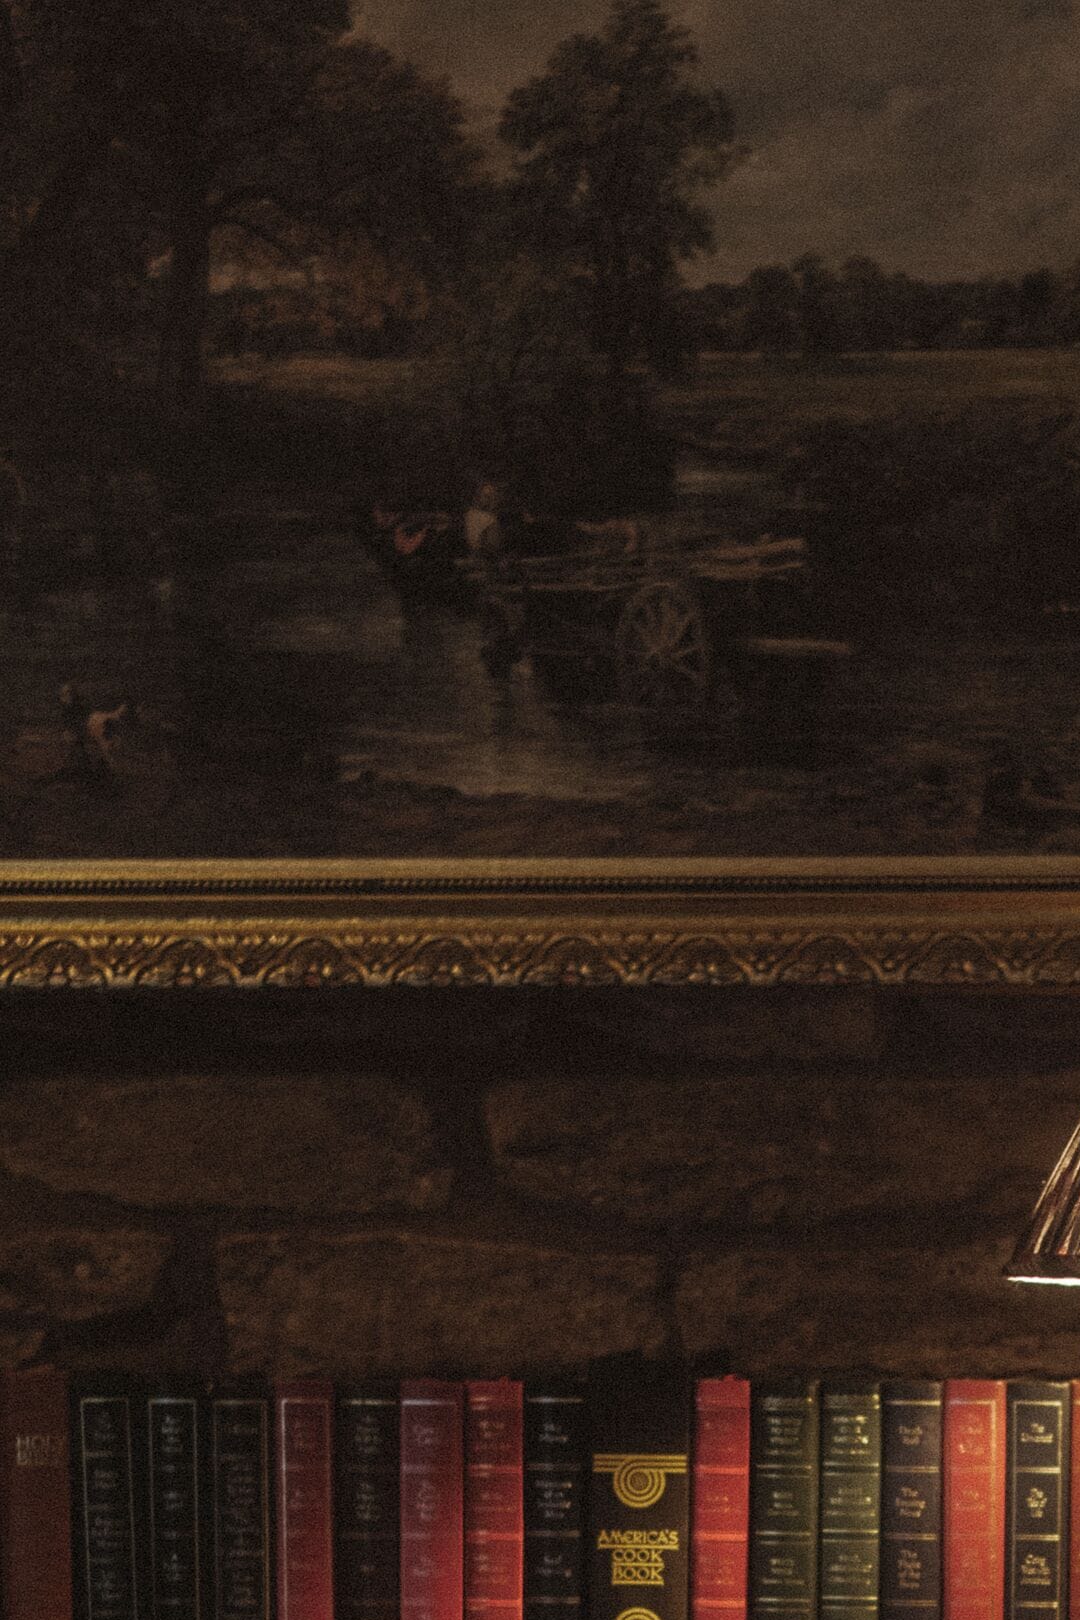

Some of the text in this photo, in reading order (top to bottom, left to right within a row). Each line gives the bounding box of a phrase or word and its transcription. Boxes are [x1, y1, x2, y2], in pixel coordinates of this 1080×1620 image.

[597, 1528, 680, 1545] AMERICA'S
[611, 1549, 664, 1564] COOK
[611, 1566, 664, 1582] BOOK
